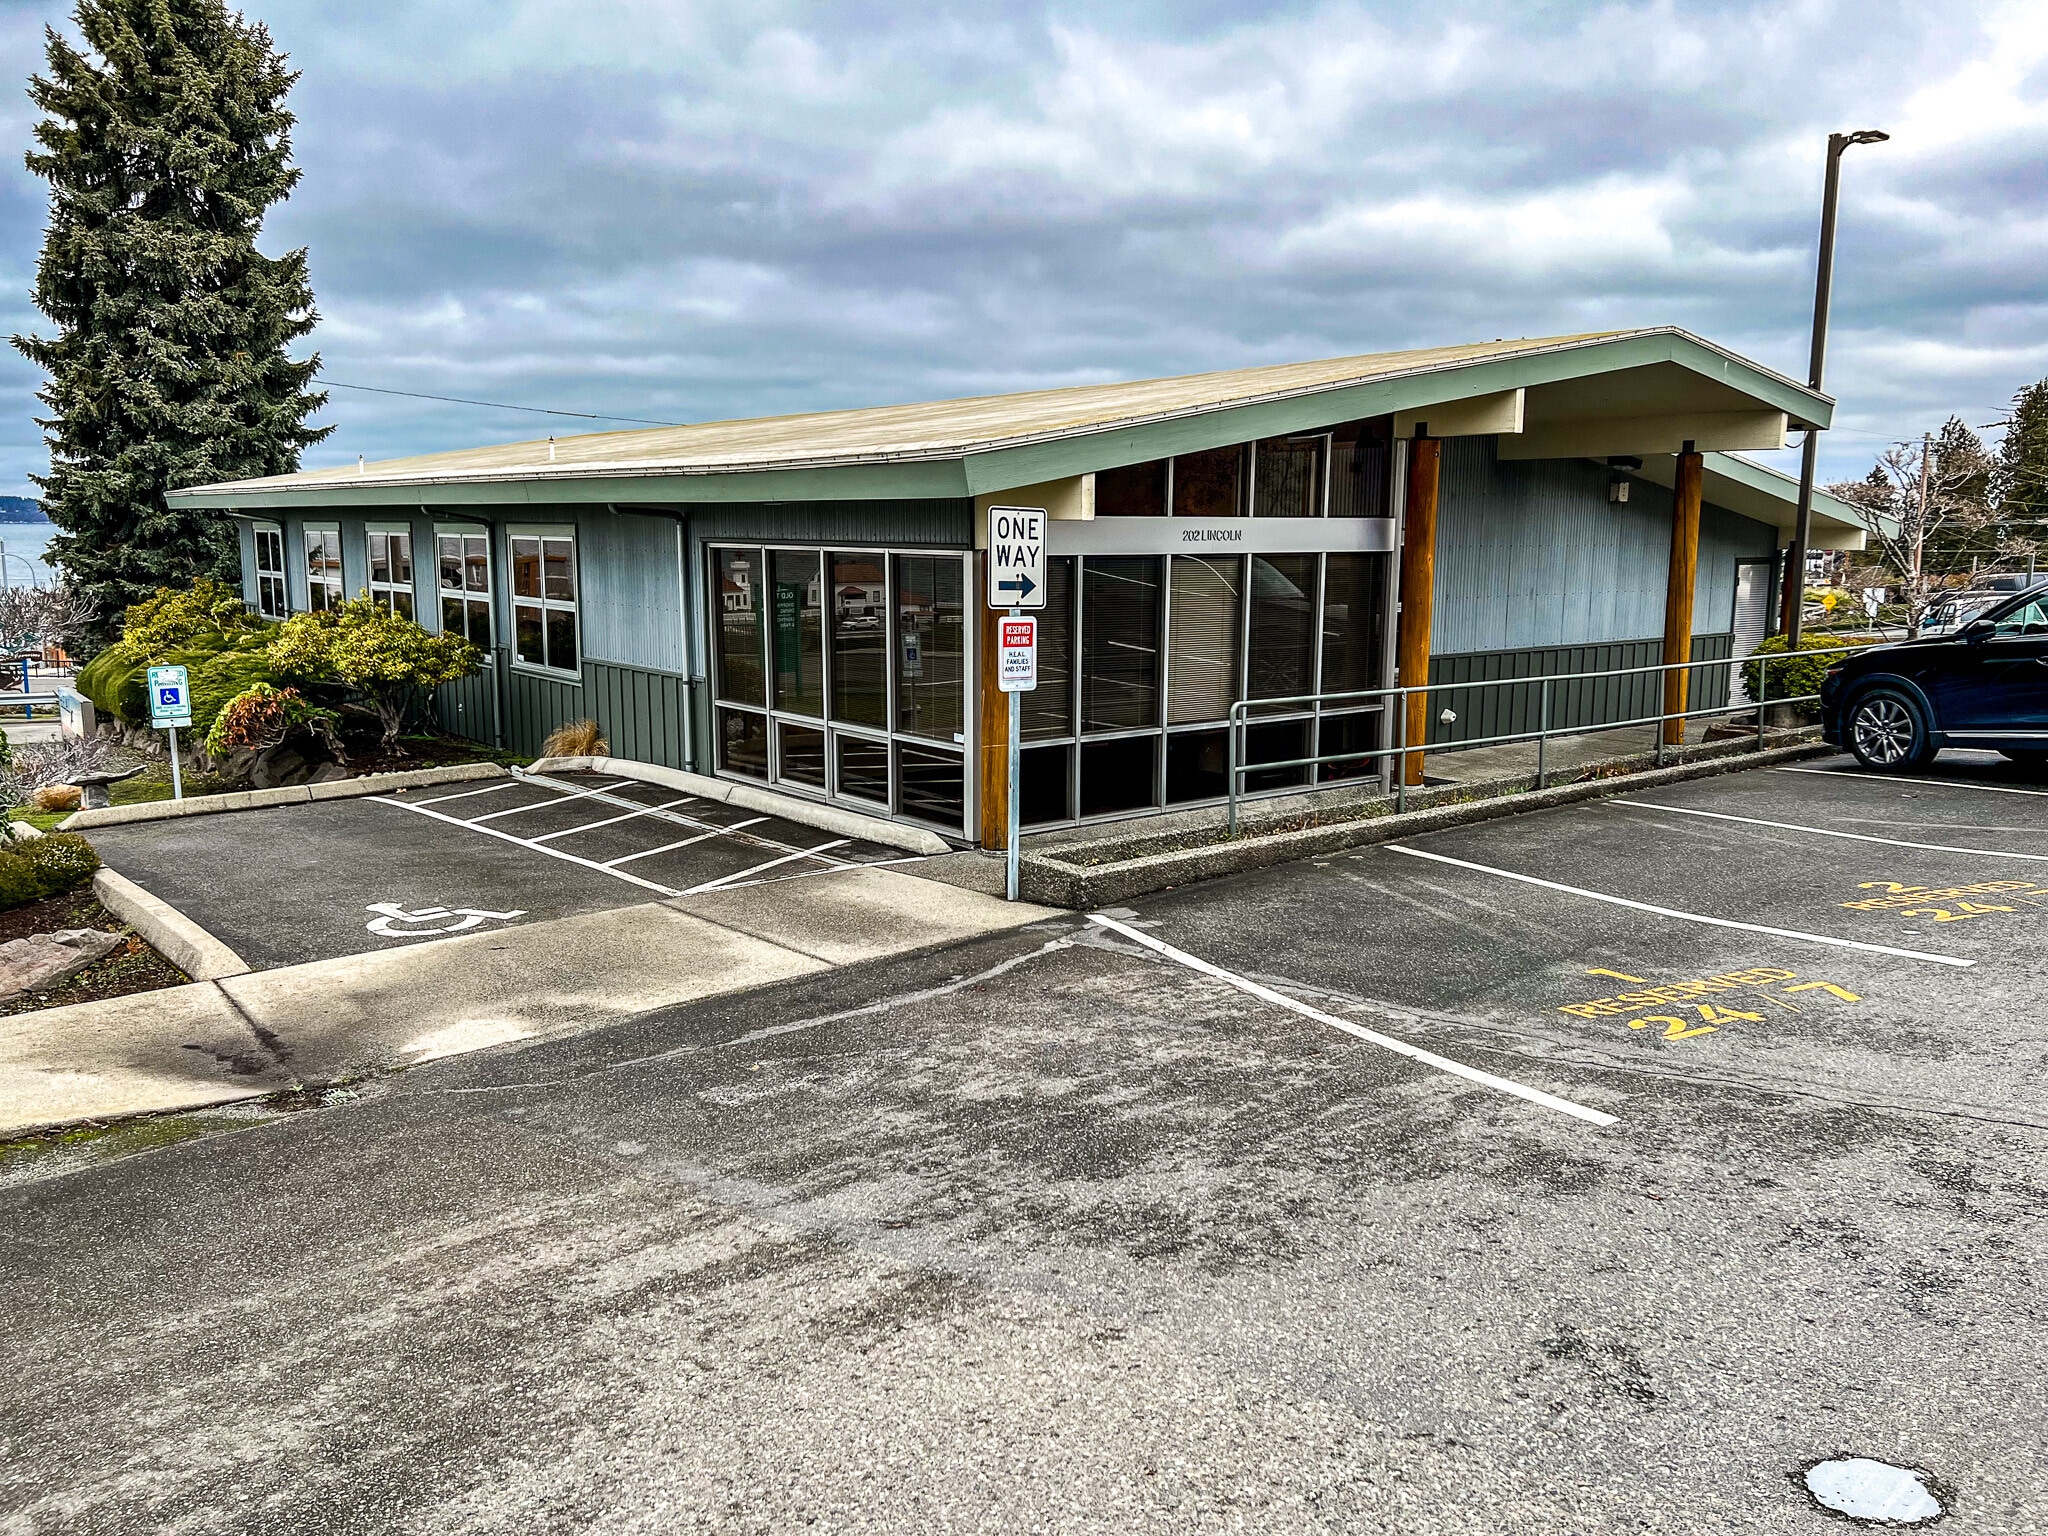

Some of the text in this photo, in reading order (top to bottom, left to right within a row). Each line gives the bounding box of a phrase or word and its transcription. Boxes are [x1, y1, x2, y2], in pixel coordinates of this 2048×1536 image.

[997, 516, 1039, 541] ONE
[1182, 529, 1242, 542] 202 LINCOLN
[996, 544, 1040, 568] WAY
[1005, 625, 1031, 635] RESERVED
[1006, 635, 1030, 645] PARKING
[1837, 880, 2037, 911] RESERVED
[1858, 881, 1929, 894] 2
[1586, 967, 1649, 984] 1
[1556, 967, 1798, 1019] RESERVED
[1627, 980, 1864, 1042] 24/7
